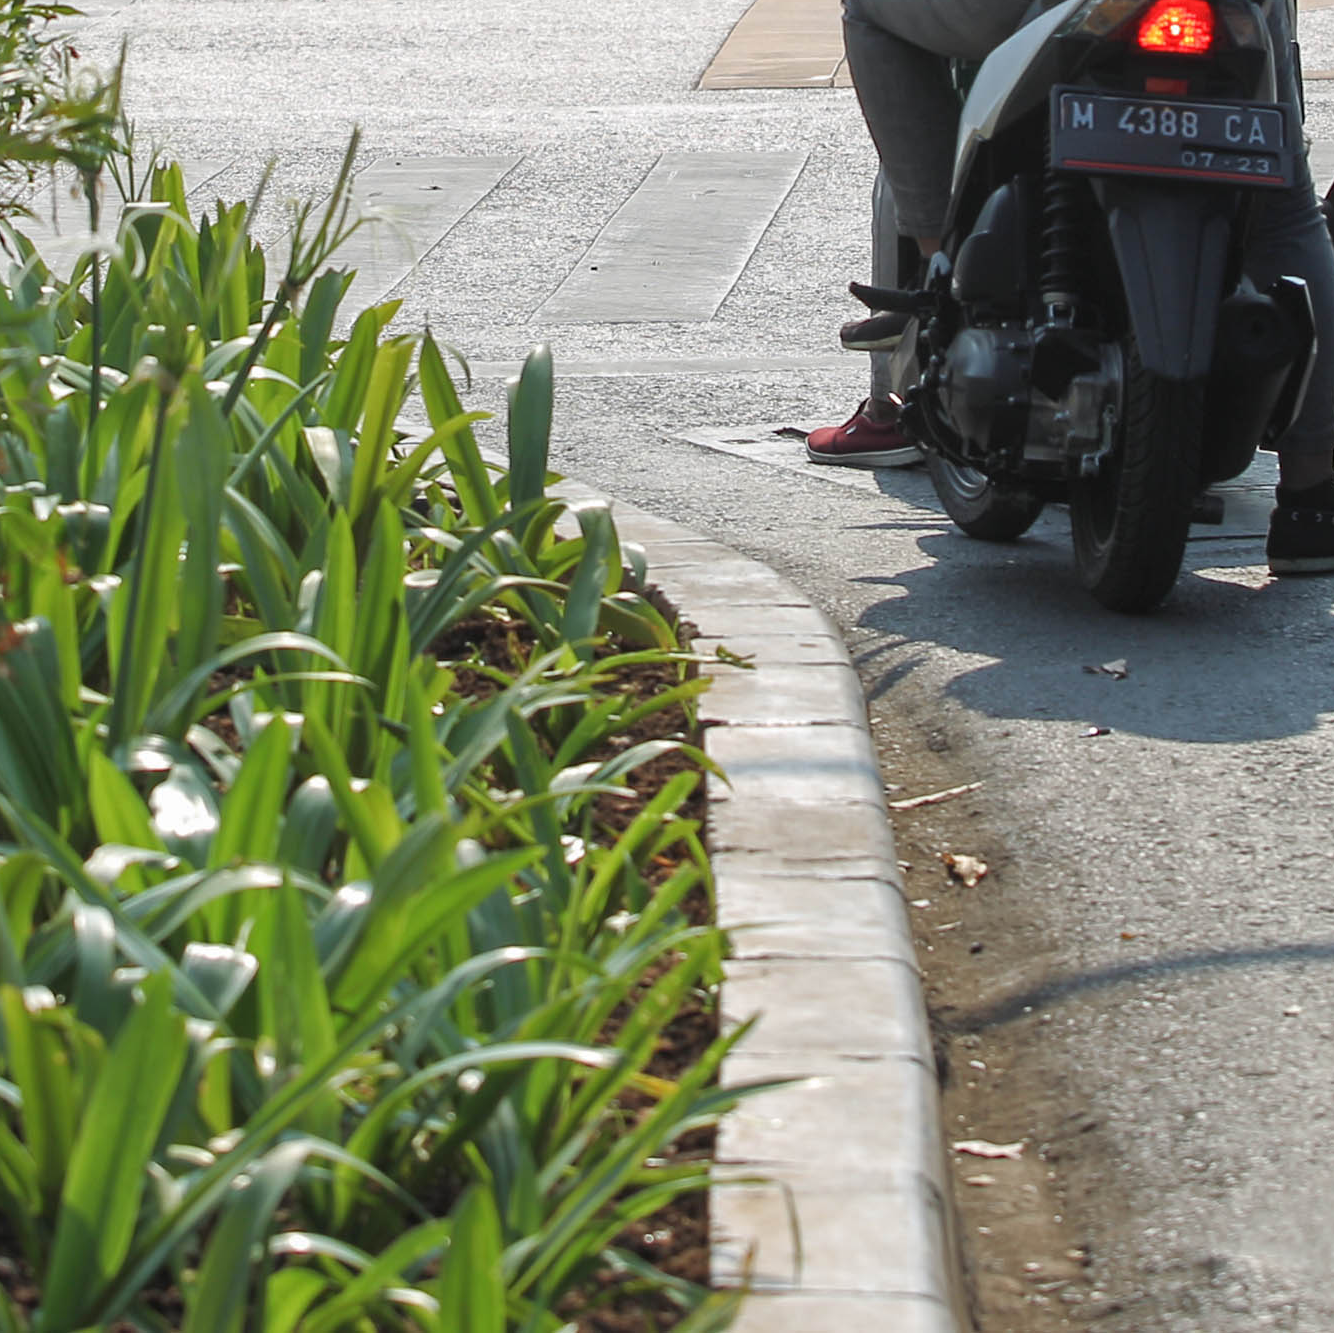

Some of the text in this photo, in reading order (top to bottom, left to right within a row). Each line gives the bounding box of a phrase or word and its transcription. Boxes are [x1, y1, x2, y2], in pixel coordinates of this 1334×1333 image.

[1073, 102, 1266, 146] M 4388 CA
